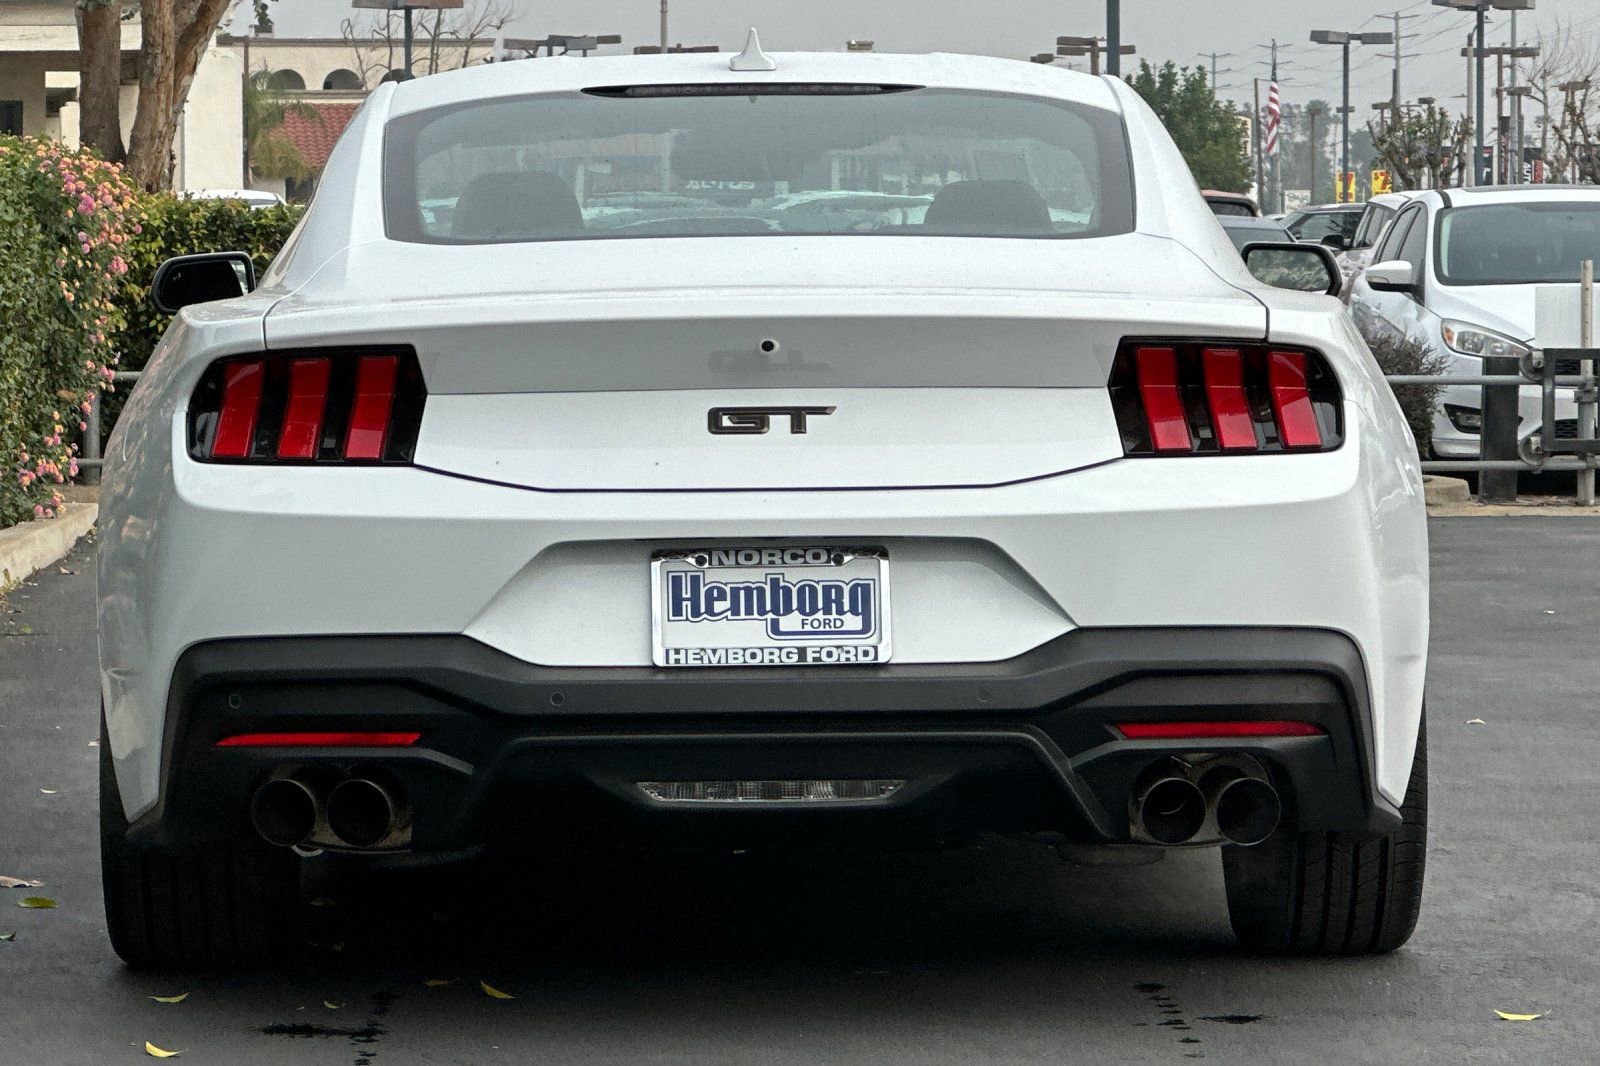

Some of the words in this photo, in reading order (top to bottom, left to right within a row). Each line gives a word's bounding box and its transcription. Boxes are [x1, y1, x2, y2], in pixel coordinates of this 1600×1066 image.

[707, 405, 837, 435] GT
[711, 549, 829, 566] NORCO
[667, 571, 876, 639] Hemborg
[801, 618, 845, 630] FORD
[668, 647, 798, 665] HEMBORG
[806, 645, 875, 662] FORD
